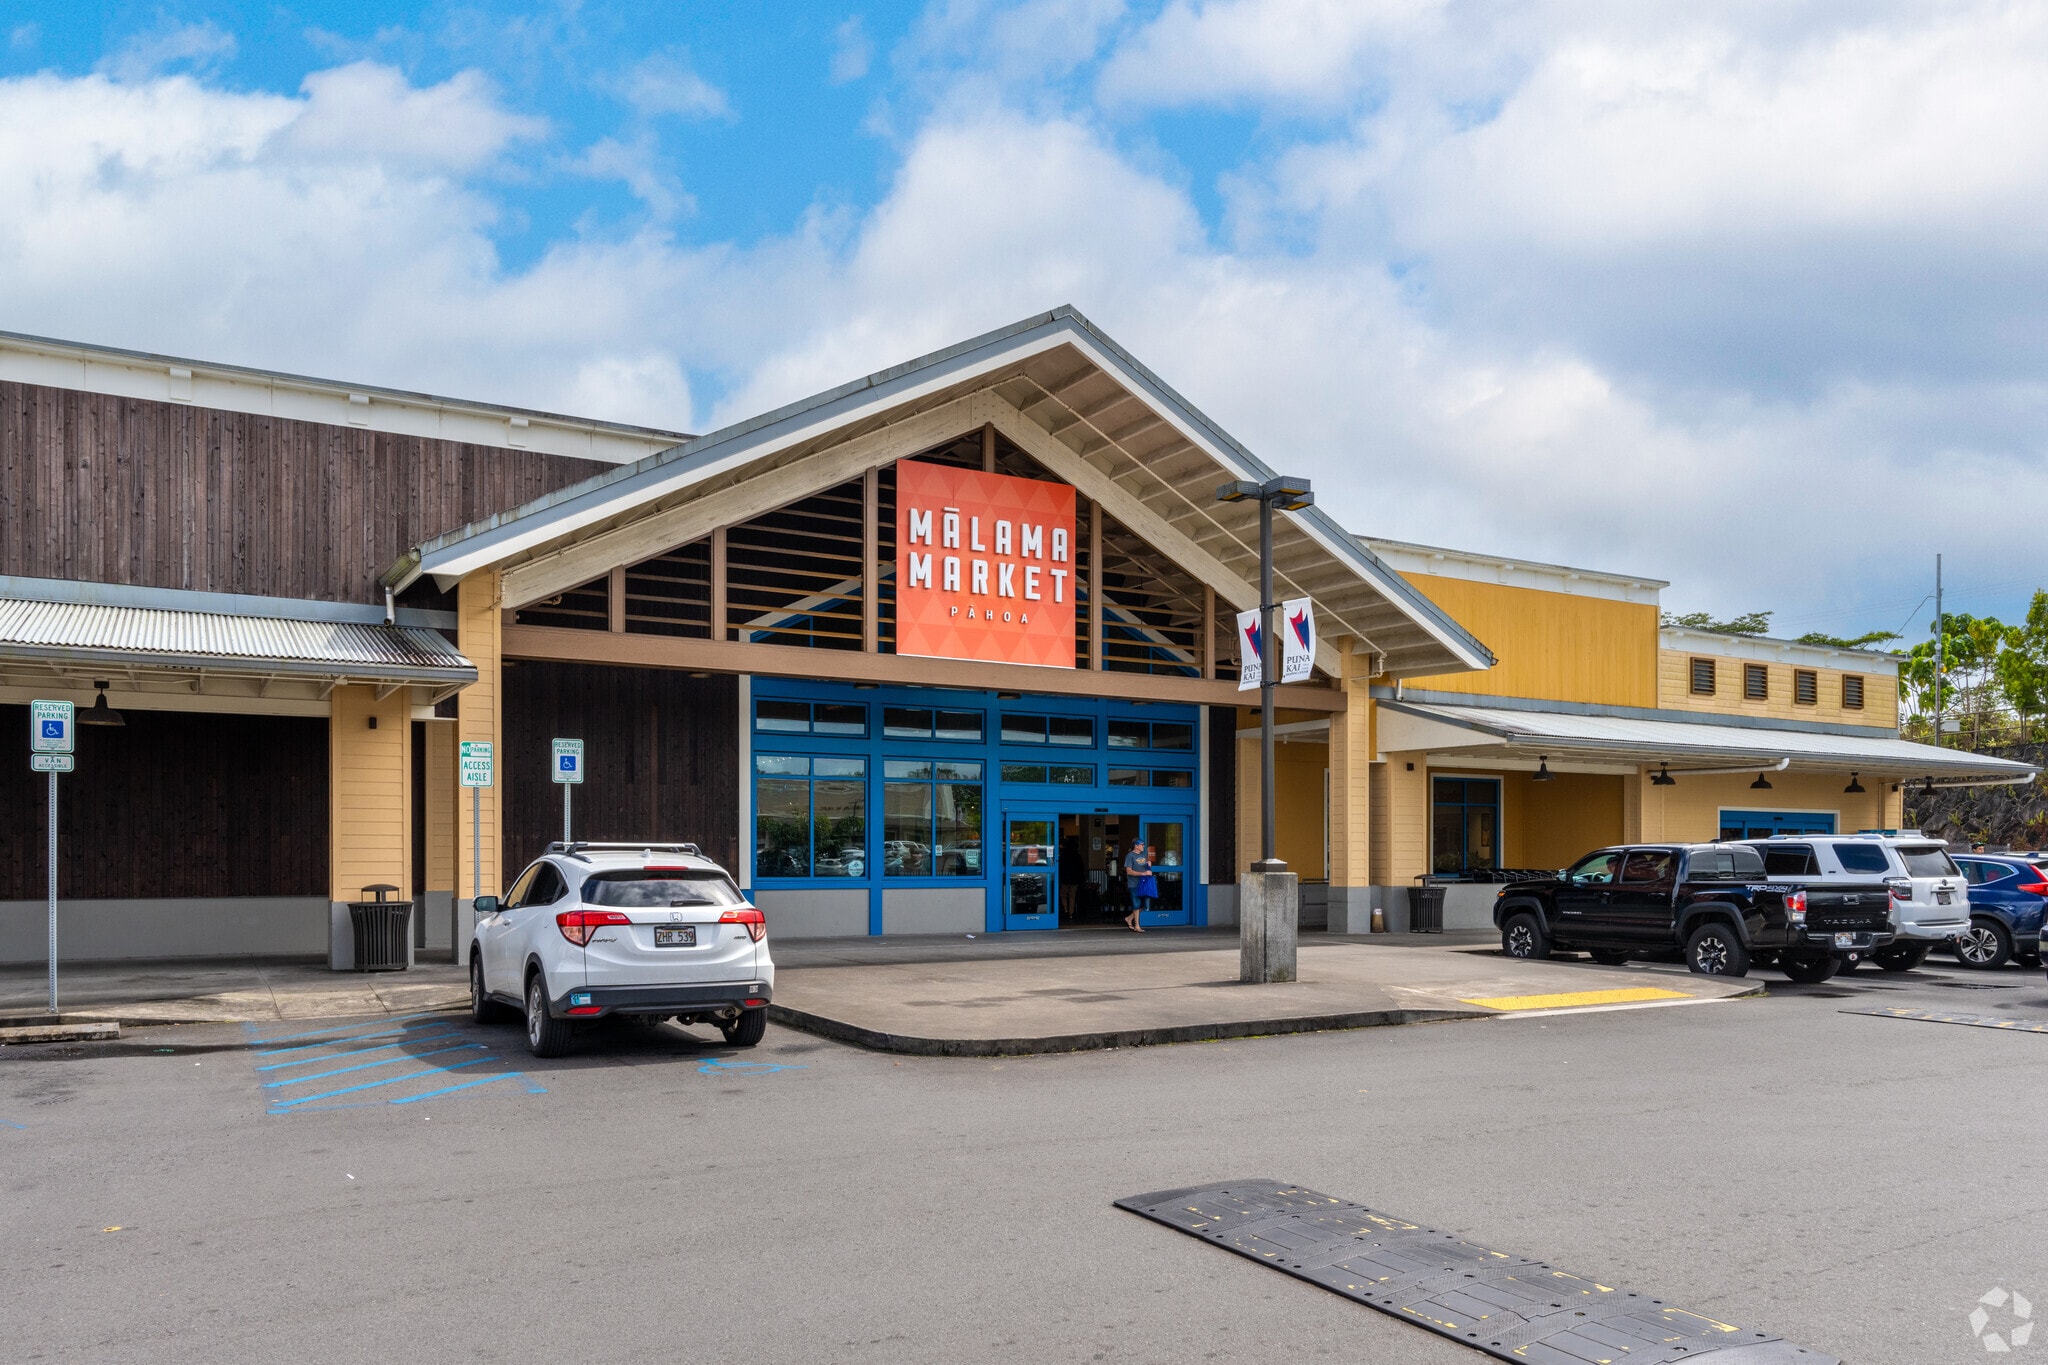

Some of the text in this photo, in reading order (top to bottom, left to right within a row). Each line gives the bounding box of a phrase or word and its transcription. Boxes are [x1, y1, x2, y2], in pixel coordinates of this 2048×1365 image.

[909, 506, 1068, 562] MĀLAMA
[909, 551, 1068, 603] MARKET
[950, 604, 1029, 624] PĀHOA
[1287, 655, 1310, 664] PUNA
[1286, 664, 1301, 672] KAI
[1243, 672, 1256, 681] KAI
[34, 703, 71, 712] RESERVED
[37, 712, 69, 720] PARKING
[461, 744, 491, 754] NO PARKING
[554, 741, 581, 749] RESERVED
[463, 761, 491, 771] ACCESS
[467, 772, 487, 782] AISLE
[656, 931, 694, 943] ZHR 539
